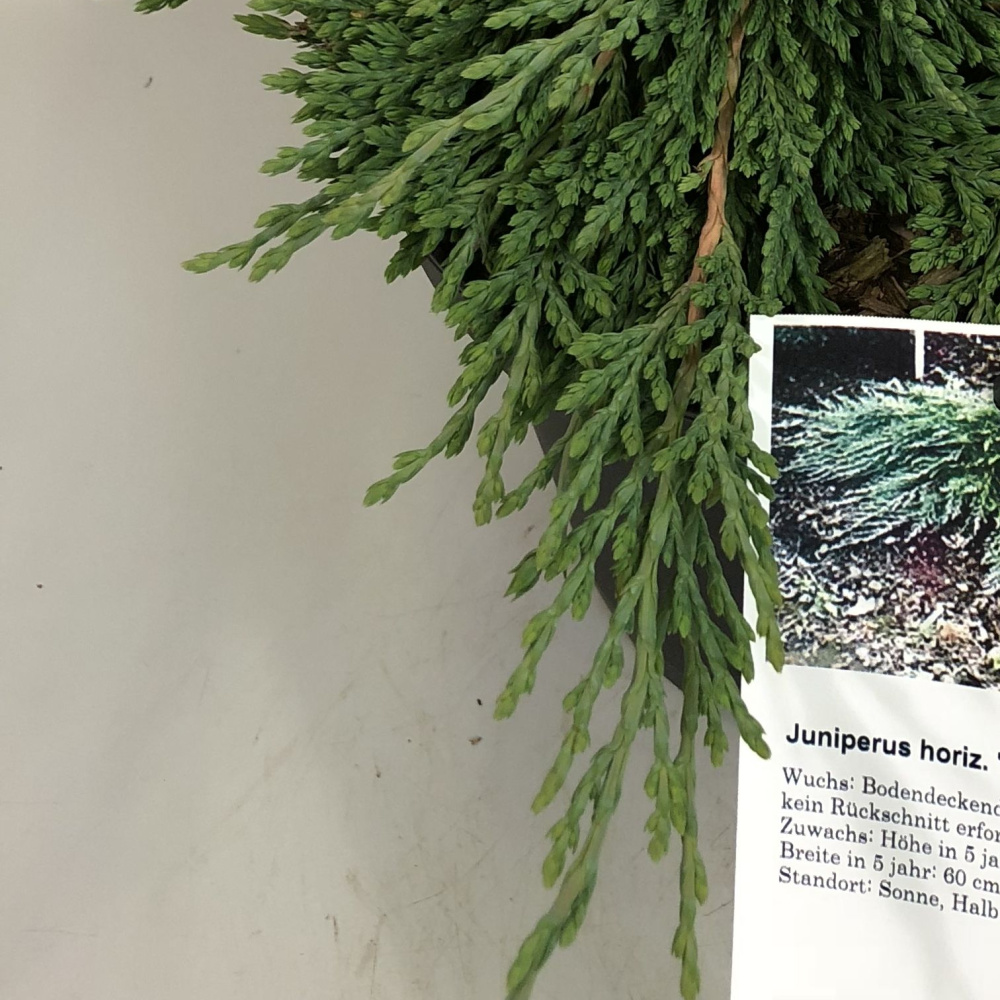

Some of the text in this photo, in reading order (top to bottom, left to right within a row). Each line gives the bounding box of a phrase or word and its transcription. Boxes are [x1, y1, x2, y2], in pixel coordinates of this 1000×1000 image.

[785, 722, 912, 758] Juniperus
[919, 738, 989, 772] horiz.
[782, 766, 855, 792] Wuchs:
[781, 790, 824, 814] kein
[830, 796, 951, 833] Rückschnitt
[779, 815, 874, 845] Zuwachs:
[880, 828, 933, 856] Höhe
[938, 839, 958, 860] in
[964, 844, 976, 863] 5
[778, 865, 872, 895] Standort:
[878, 879, 944, 912] Sonne,
[779, 840, 1000, 895] Breite in 5 jahr: 60 cm
